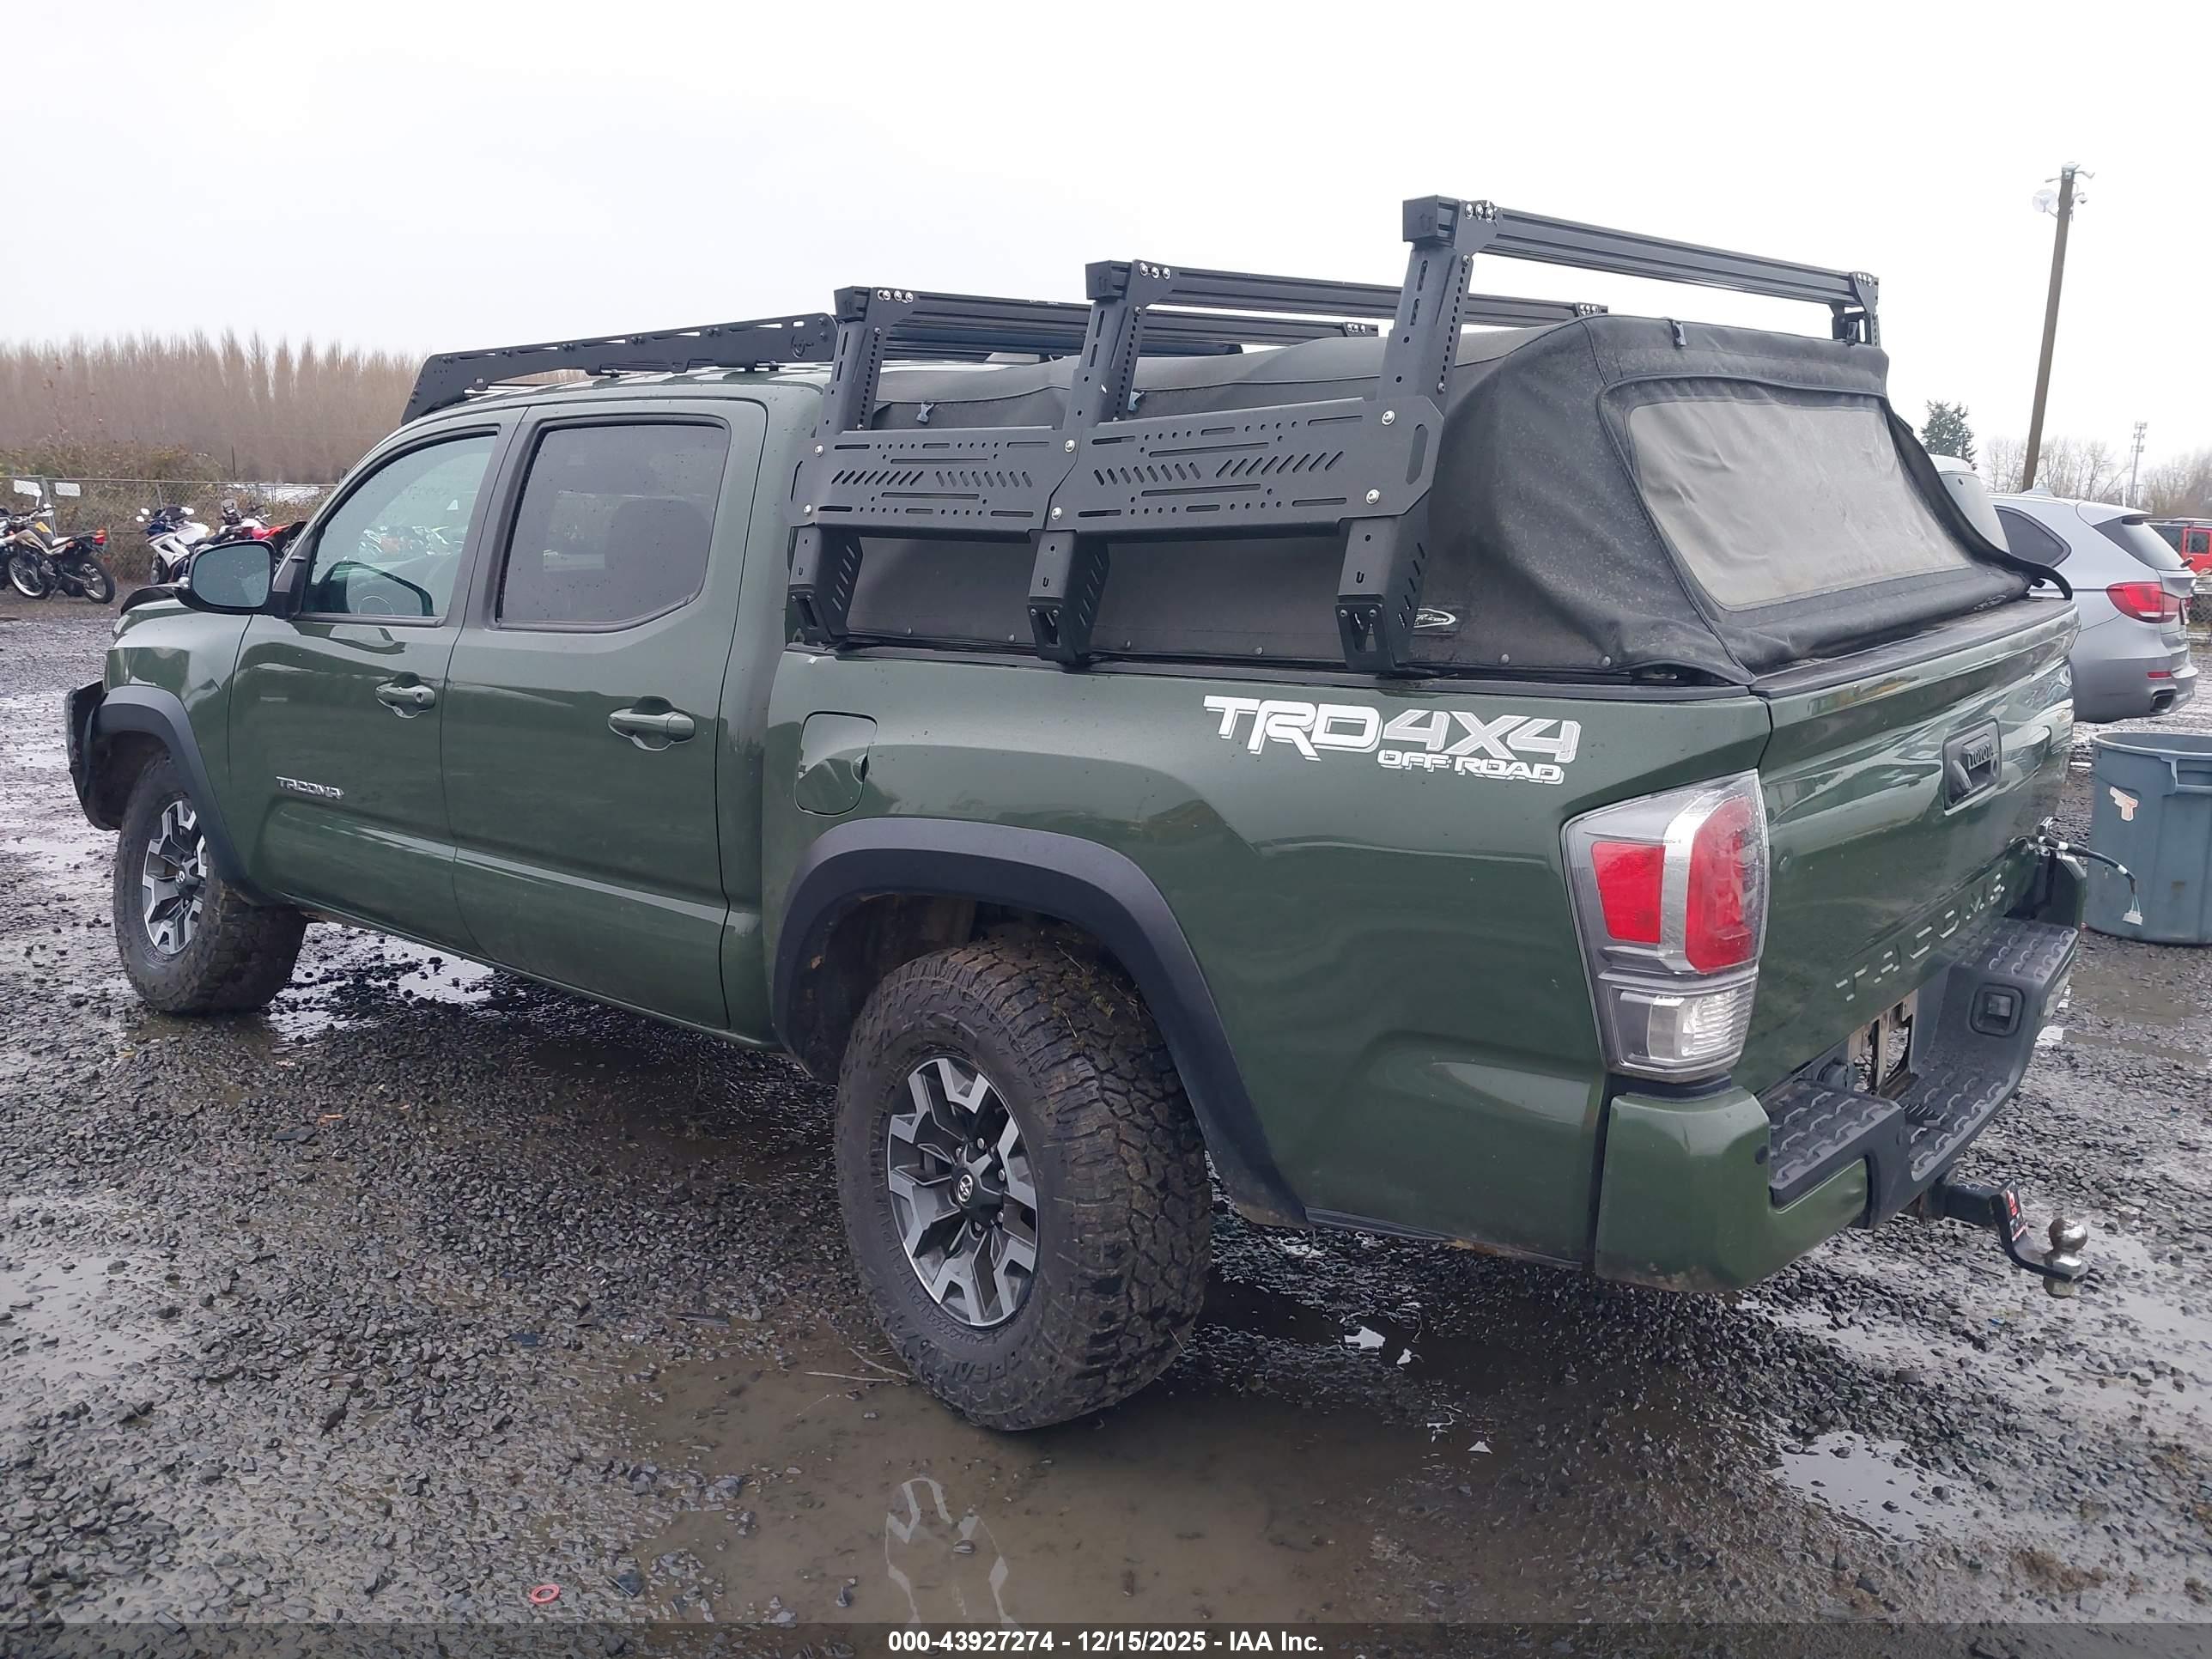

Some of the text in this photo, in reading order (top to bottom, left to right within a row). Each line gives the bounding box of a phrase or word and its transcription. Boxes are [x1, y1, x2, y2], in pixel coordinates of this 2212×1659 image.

[1203, 695, 1582, 763] TRD 4X4
[1377, 749, 1565, 785] OFF ROAD
[275, 775, 344, 799] TACOMA
